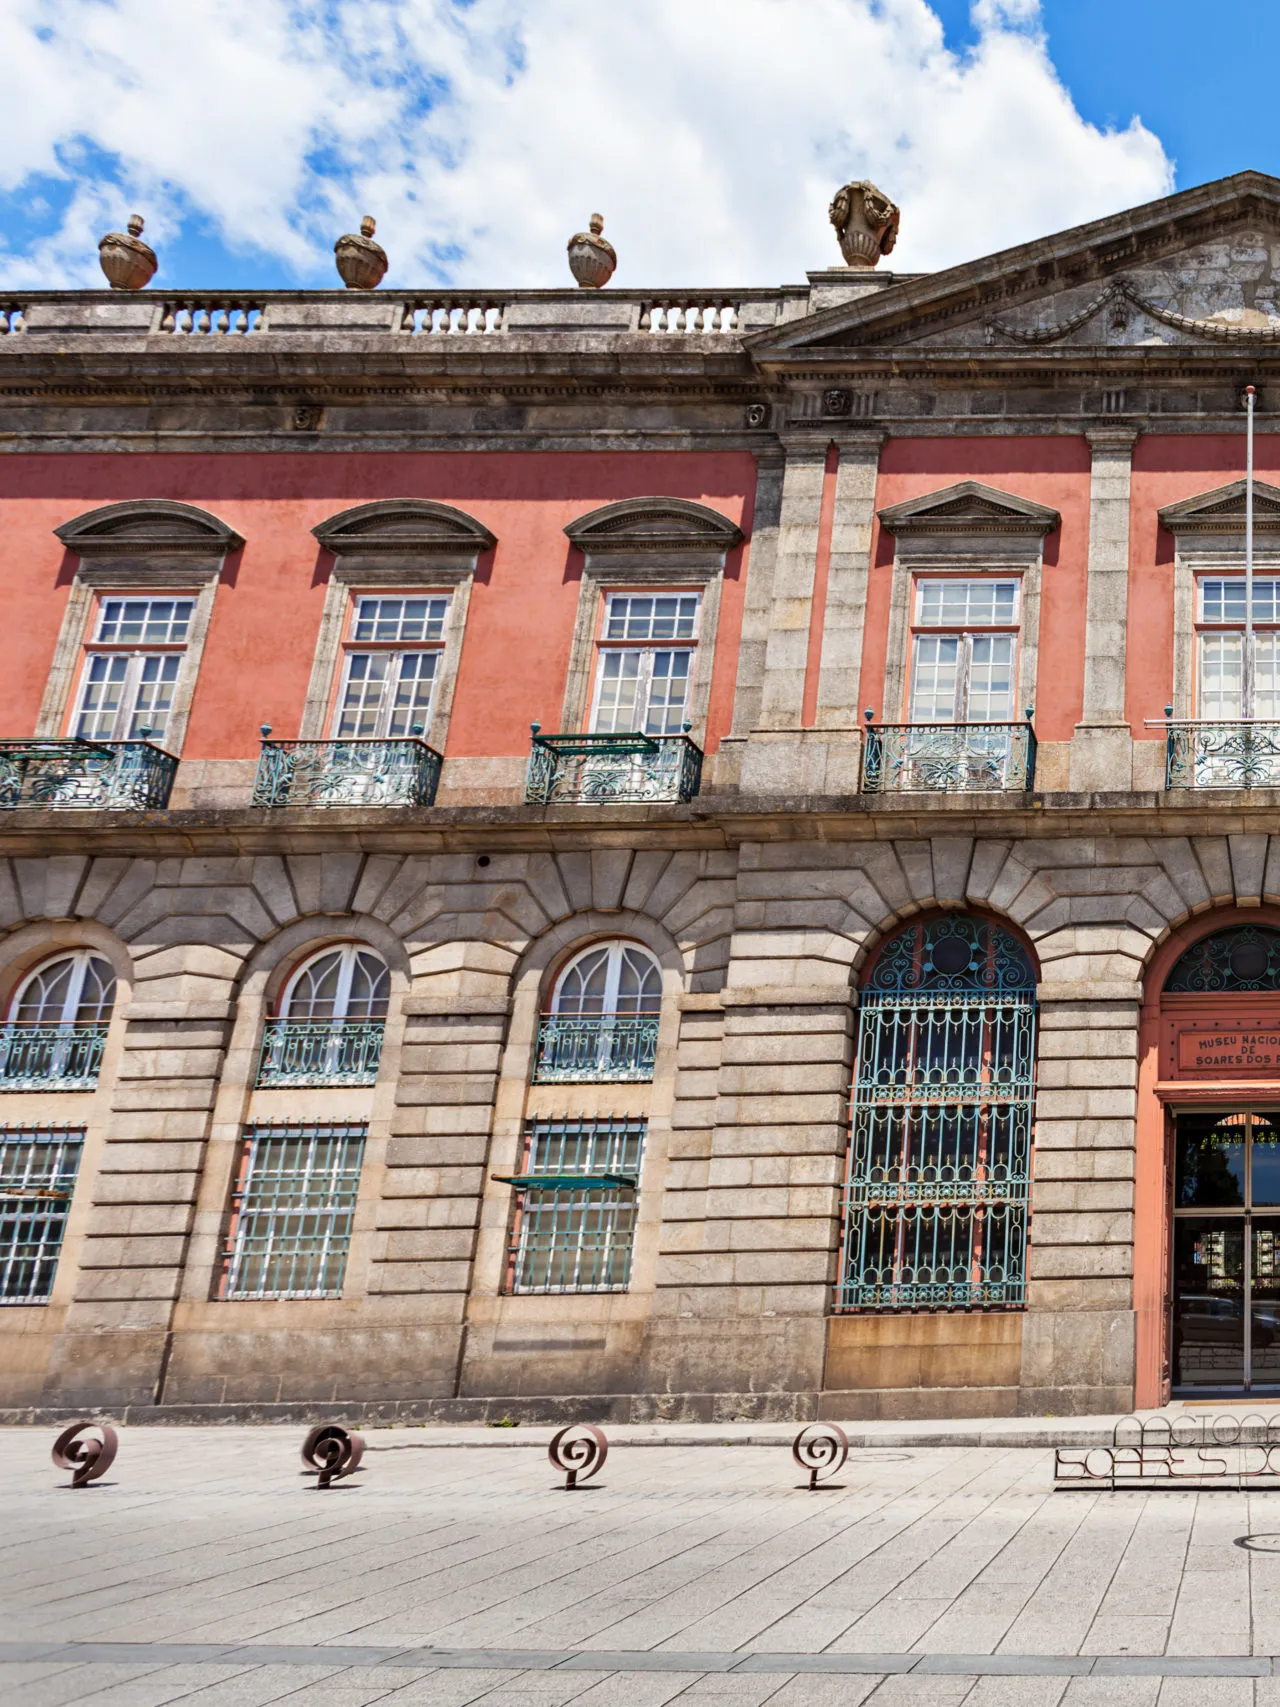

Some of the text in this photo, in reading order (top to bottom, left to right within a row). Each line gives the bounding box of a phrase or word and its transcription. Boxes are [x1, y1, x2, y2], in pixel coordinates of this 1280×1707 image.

[1199, 1036, 1237, 1049] MUSEU
[1241, 1046, 1255, 1054] DE
[1196, 1055, 1243, 1065] SOARES
[1246, 1055, 1271, 1064] DOS
